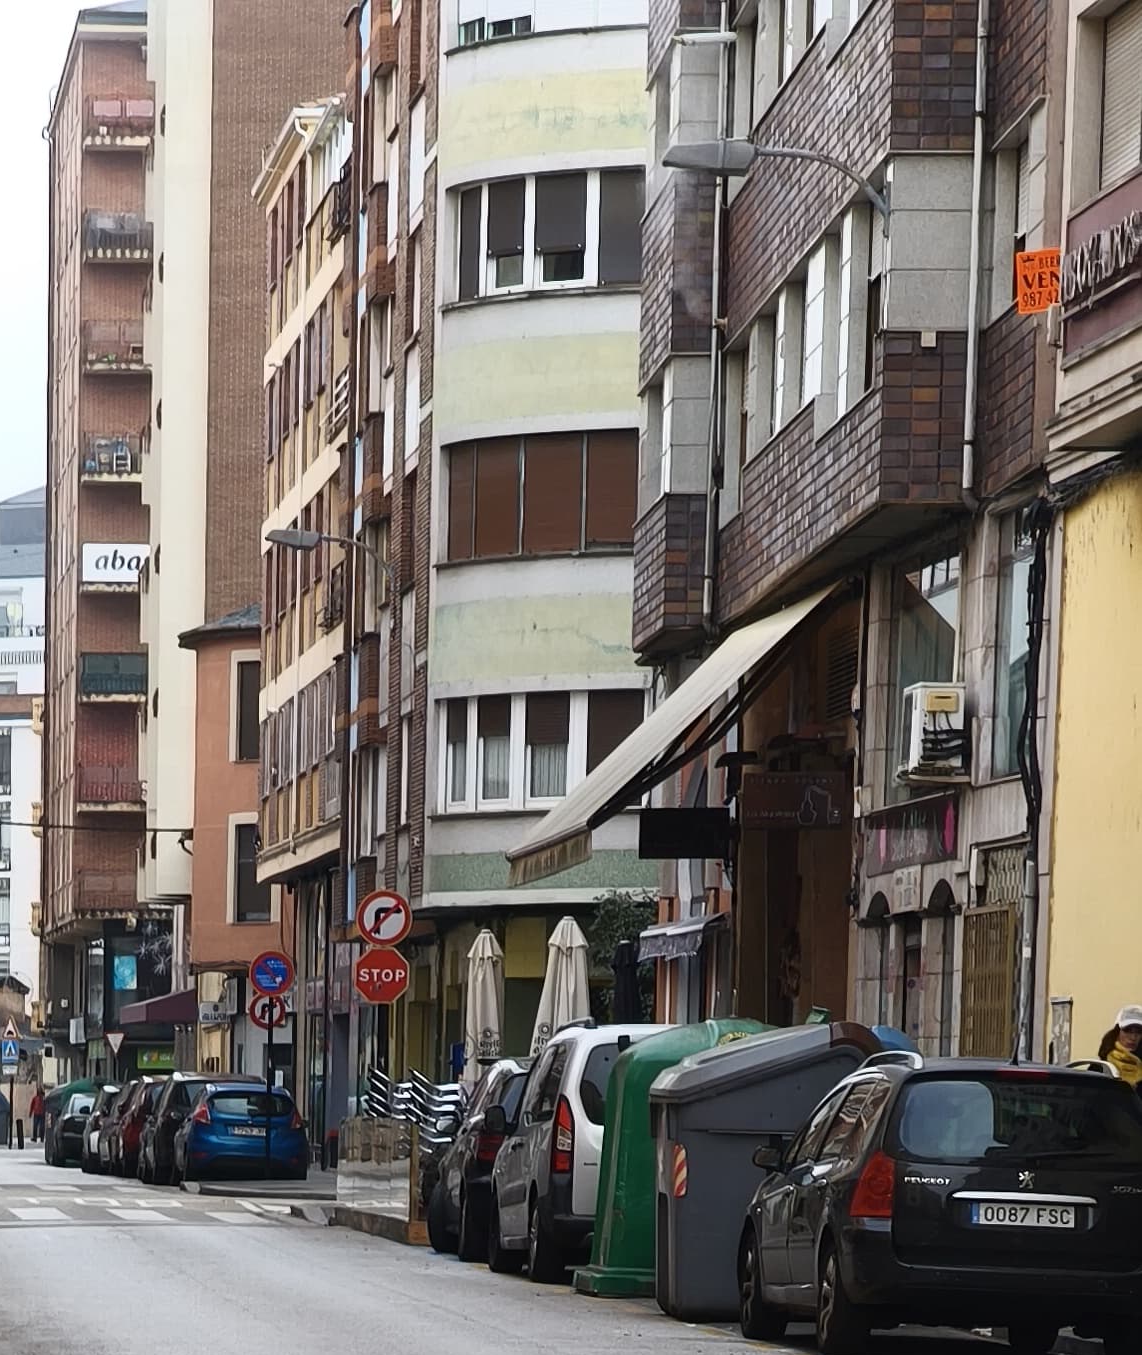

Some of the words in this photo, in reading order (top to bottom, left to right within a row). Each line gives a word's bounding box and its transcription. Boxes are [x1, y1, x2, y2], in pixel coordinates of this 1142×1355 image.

[1022, 291, 1043, 307] 987
[95, 548, 141, 570] aba
[359, 968, 405, 982] STOP
[904, 1176, 951, 1185] PEUGEOT
[984, 1206, 1030, 1223] 0087
[1036, 1208, 1072, 1226] FSC
